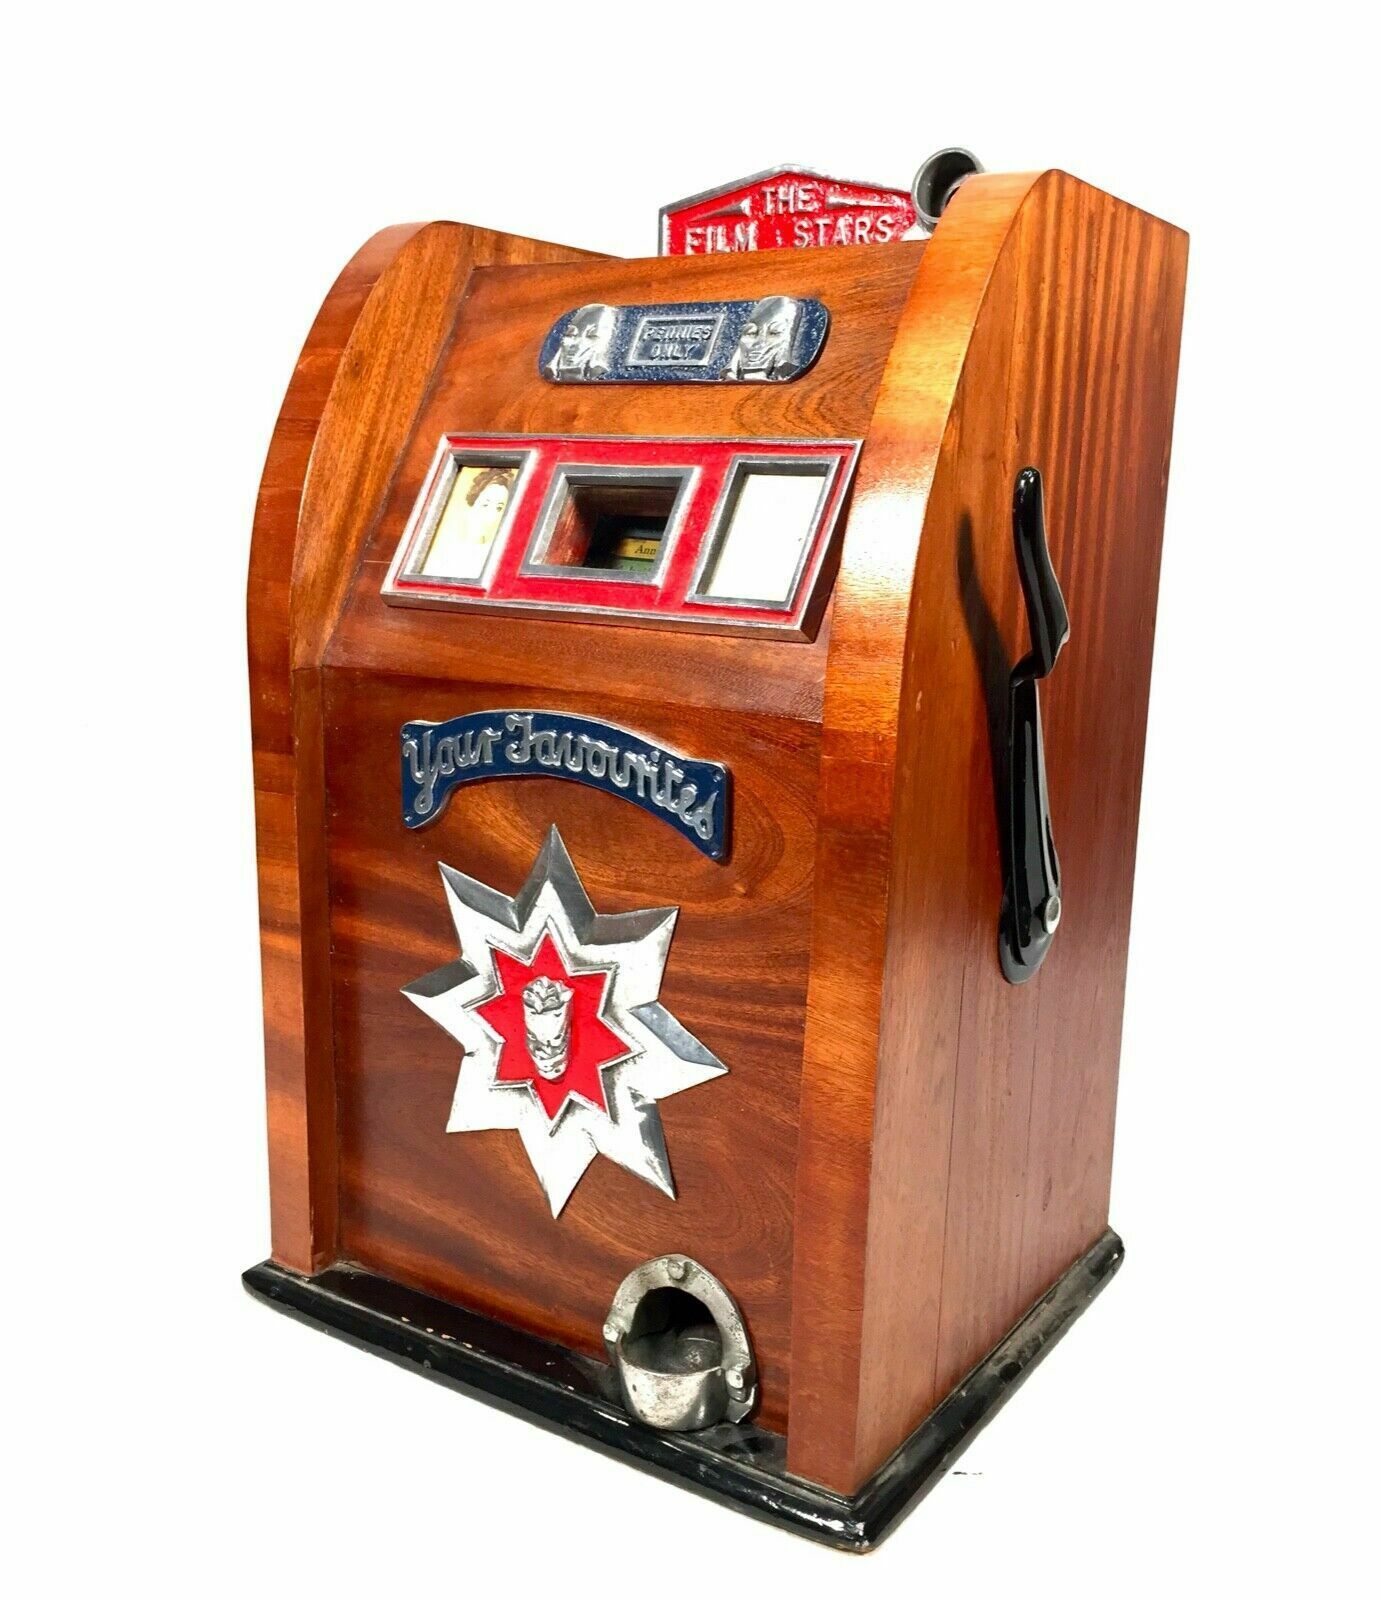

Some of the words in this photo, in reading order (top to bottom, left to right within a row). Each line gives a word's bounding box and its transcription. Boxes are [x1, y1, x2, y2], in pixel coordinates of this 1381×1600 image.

[762, 184, 820, 214] THE
[685, 220, 758, 255] FILM
[793, 214, 897, 248] STARS
[643, 324, 713, 341] PENNIES
[650, 342, 698, 360] ONLY
[402, 727, 502, 815] Your
[505, 713, 719, 840] Favourites
